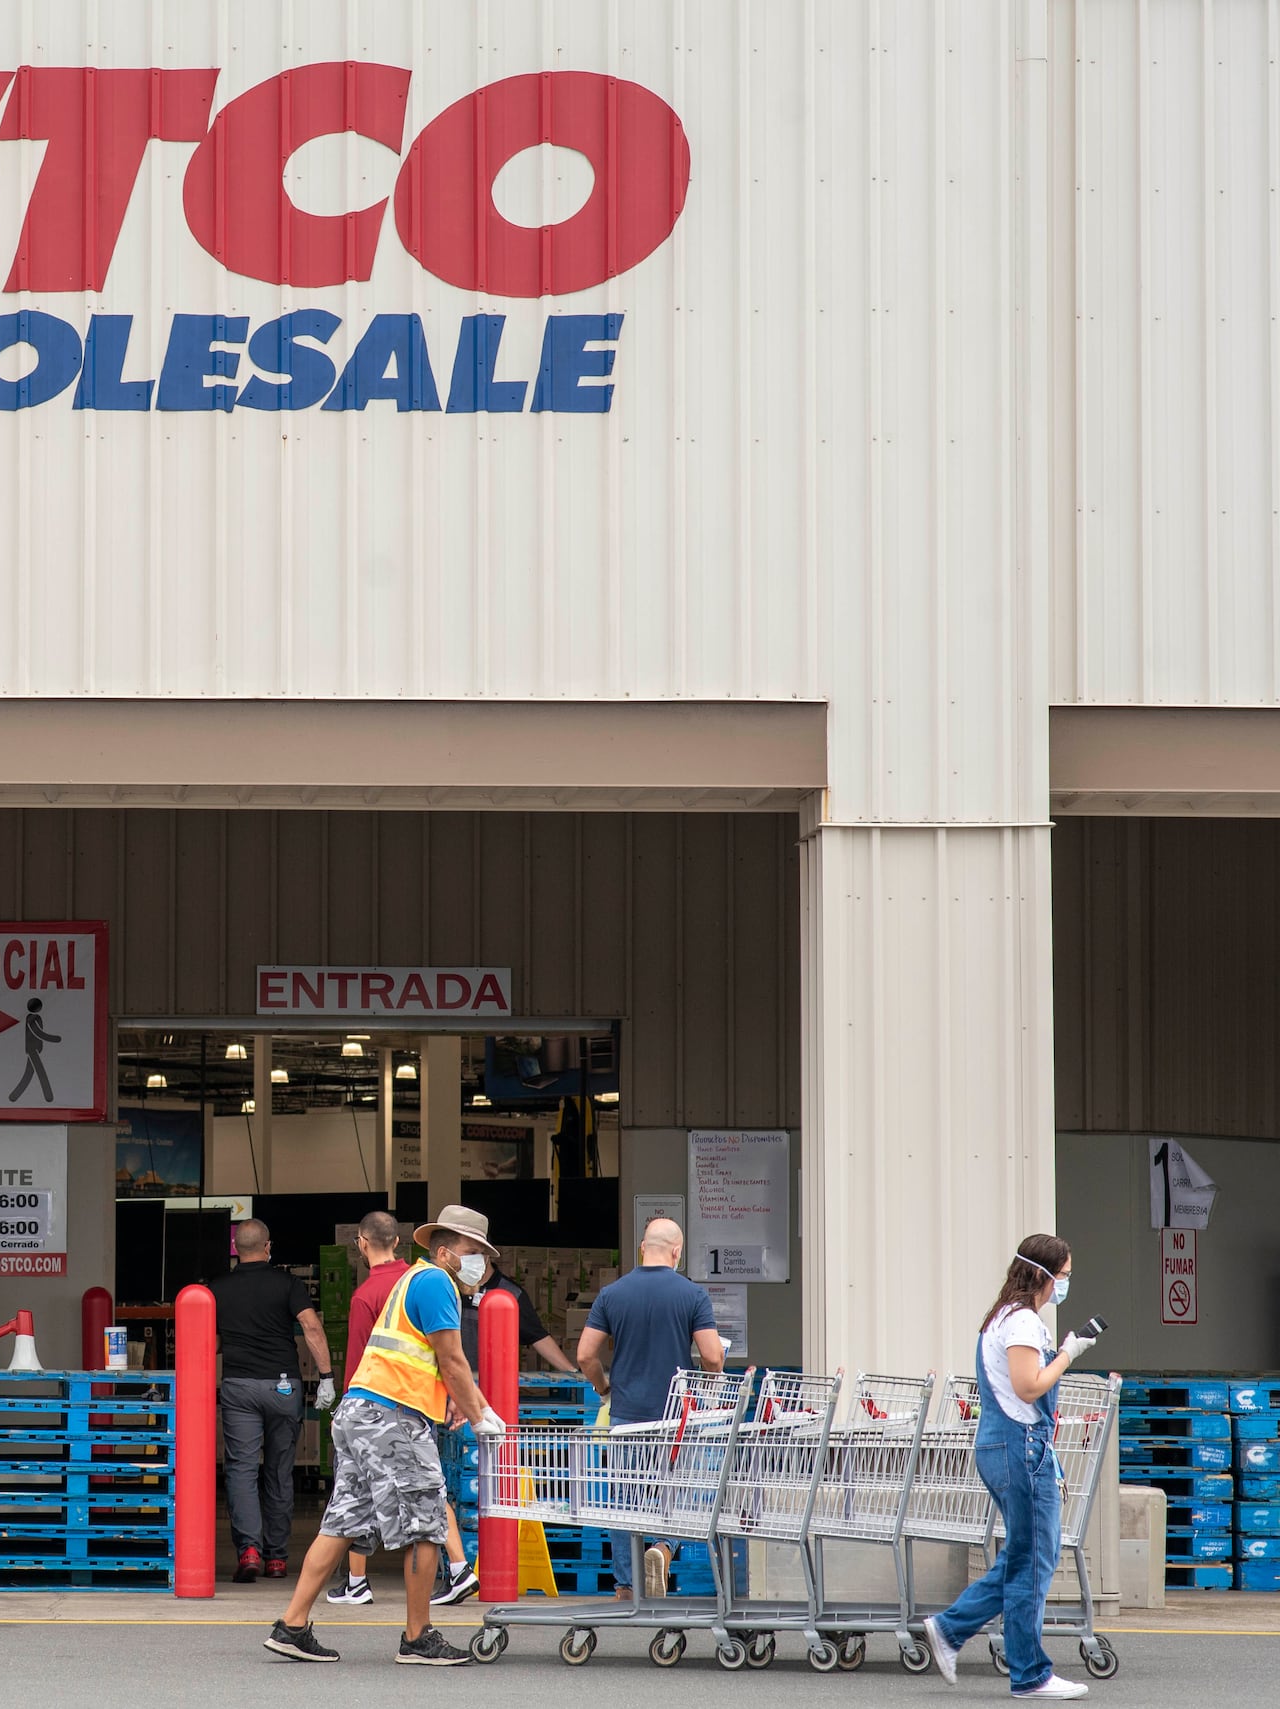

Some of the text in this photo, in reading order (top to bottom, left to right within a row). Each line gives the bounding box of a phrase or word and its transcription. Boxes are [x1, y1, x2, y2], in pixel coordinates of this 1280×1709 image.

[259, 971, 508, 1010] ENTRADA
[728, 1136, 740, 1144] NO
[1154, 1142, 1171, 1227] 1
[730, 1195, 736, 1203] C
[1173, 1233, 1185, 1250] NO
[723, 1248, 743, 1257] Socio
[710, 1248, 722, 1275] 1
[723, 1257, 746, 1266] Carrito
[1165, 1257, 1195, 1275] FUMAR
